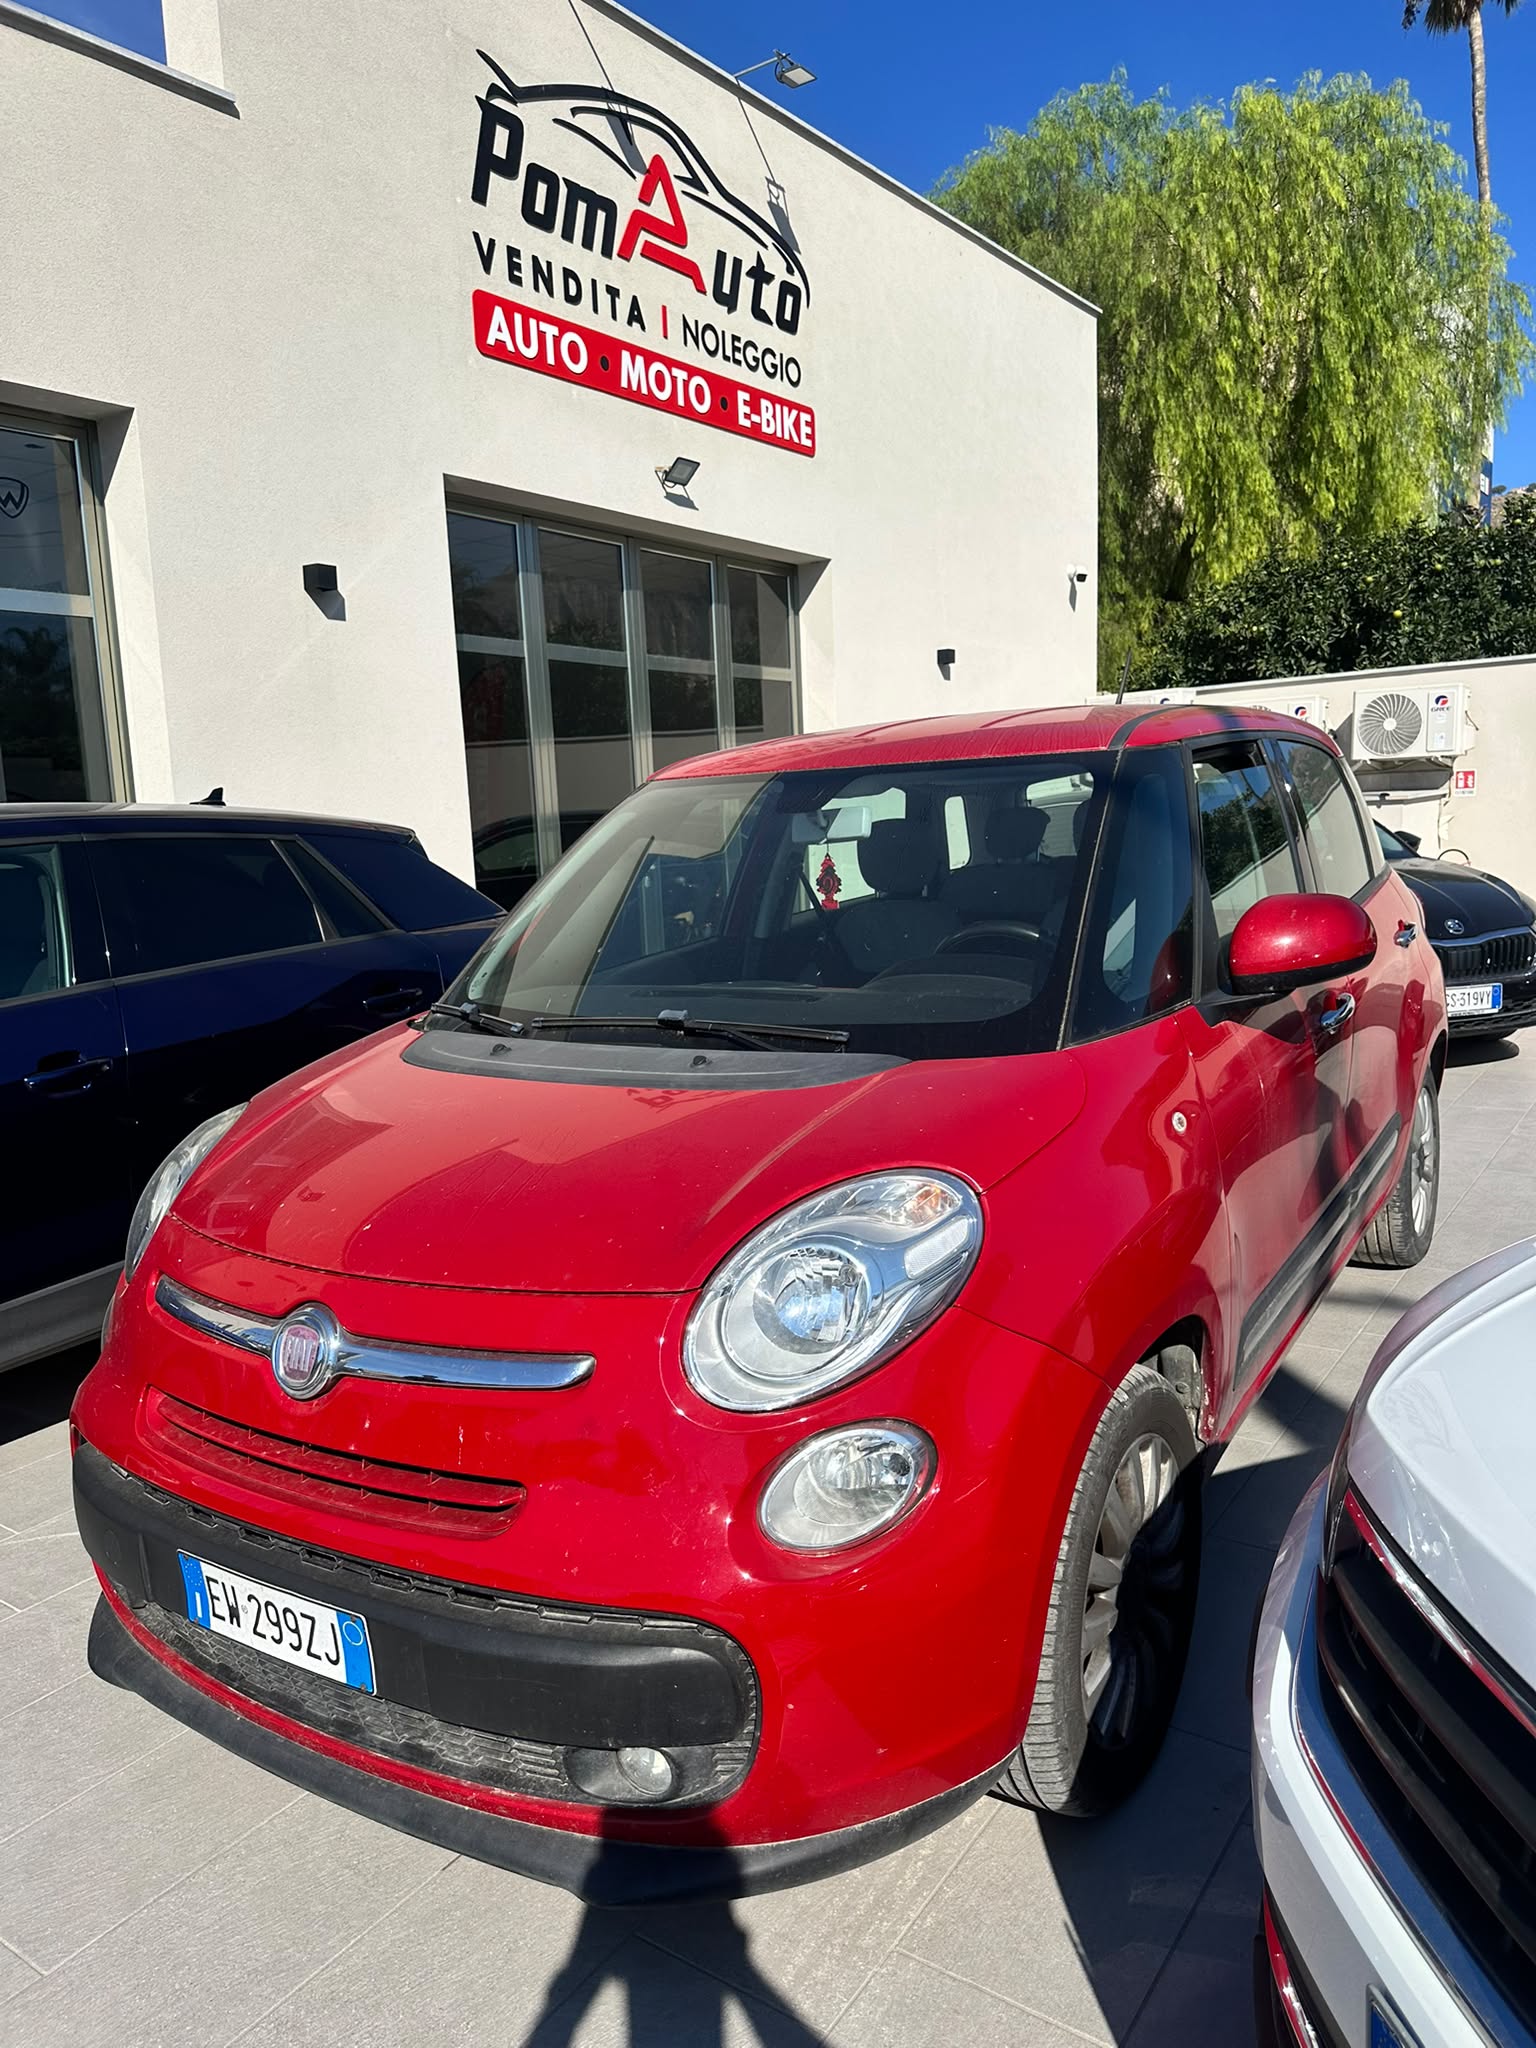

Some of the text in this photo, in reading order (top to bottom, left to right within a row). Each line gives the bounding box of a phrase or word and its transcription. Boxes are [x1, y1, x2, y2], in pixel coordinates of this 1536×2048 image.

[472, 230, 802, 388] VENDITA NOLEGGIO
[487, 305, 813, 448] AUTO MOTO E-BIKE
[1460, 990, 1491, 1007] 319VY
